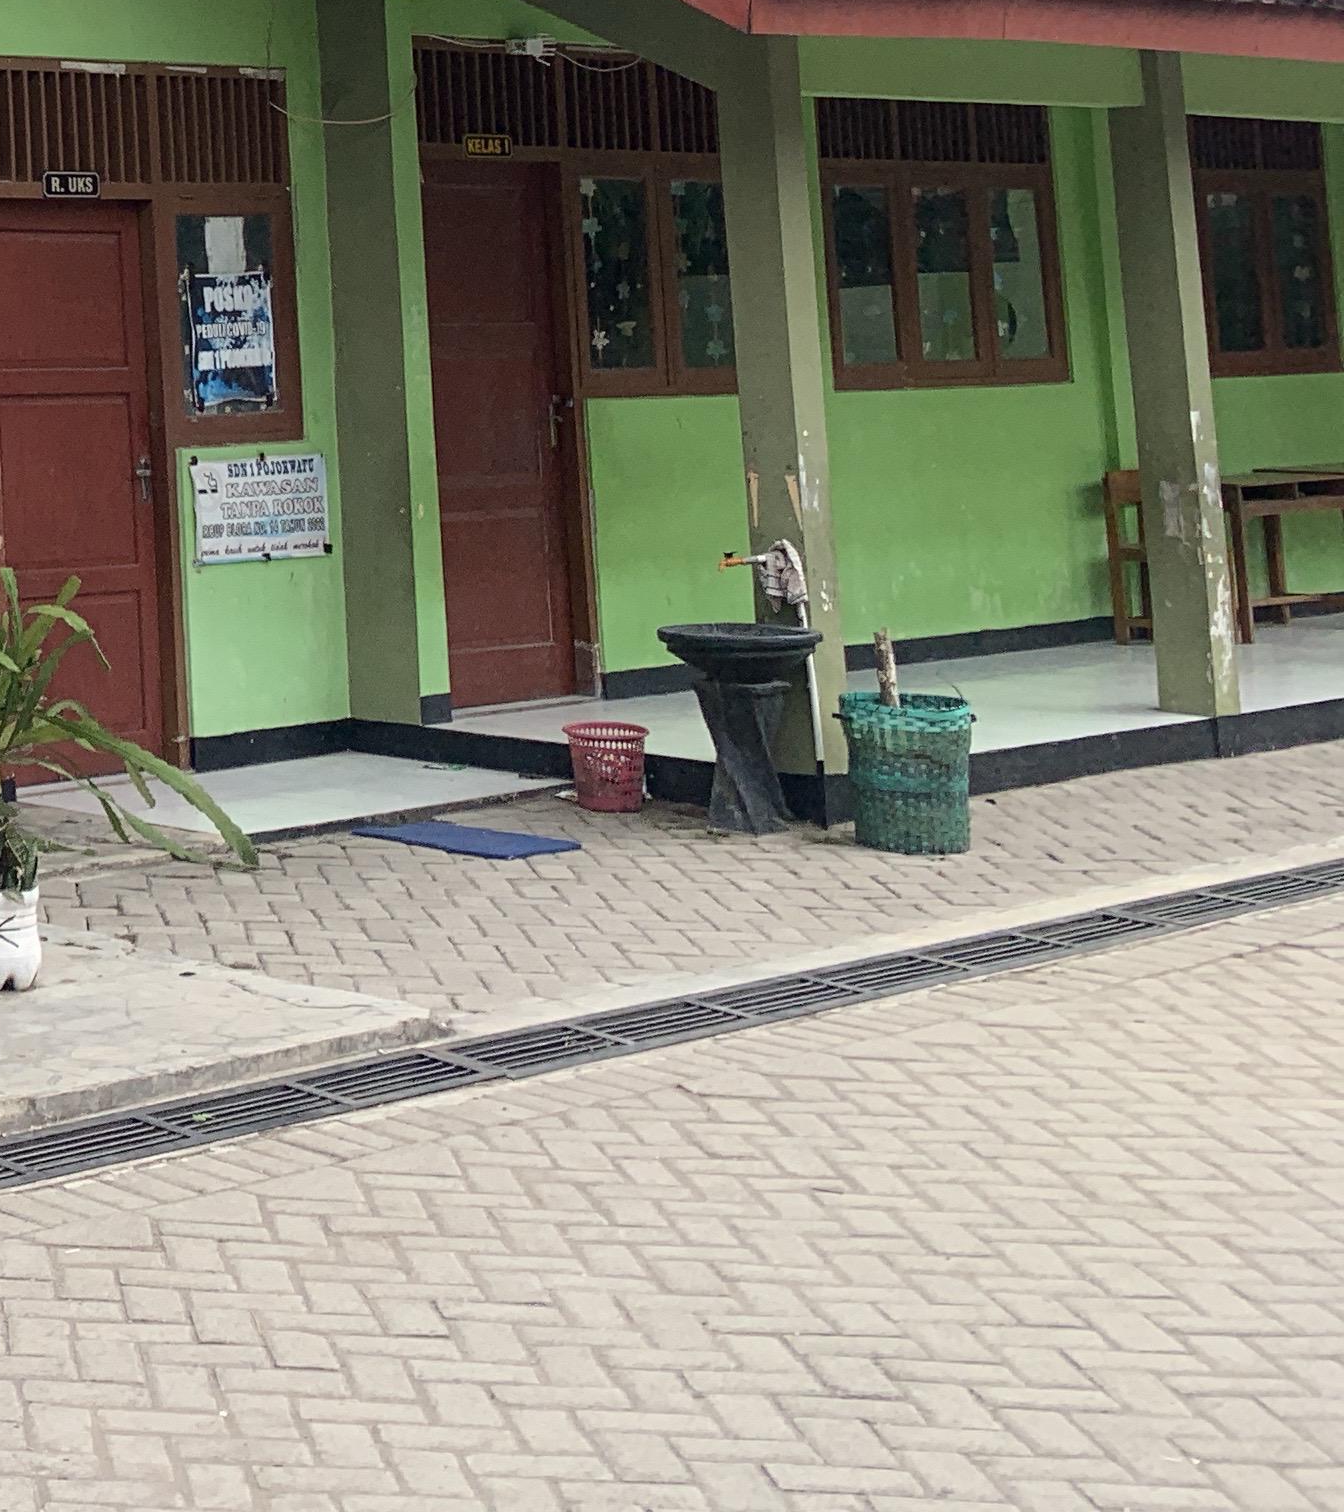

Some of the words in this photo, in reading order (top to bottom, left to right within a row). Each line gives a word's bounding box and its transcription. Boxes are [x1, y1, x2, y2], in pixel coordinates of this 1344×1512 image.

[467, 138, 501, 155] KELAS
[51, 176, 65, 193] R.
[68, 176, 94, 193] UKS
[227, 464, 248, 478] SDN
[250, 462, 255, 479] 1
[225, 477, 320, 498] KAWASAN
[220, 500, 269, 519] TANPA
[272, 496, 325, 516] ROKOK
